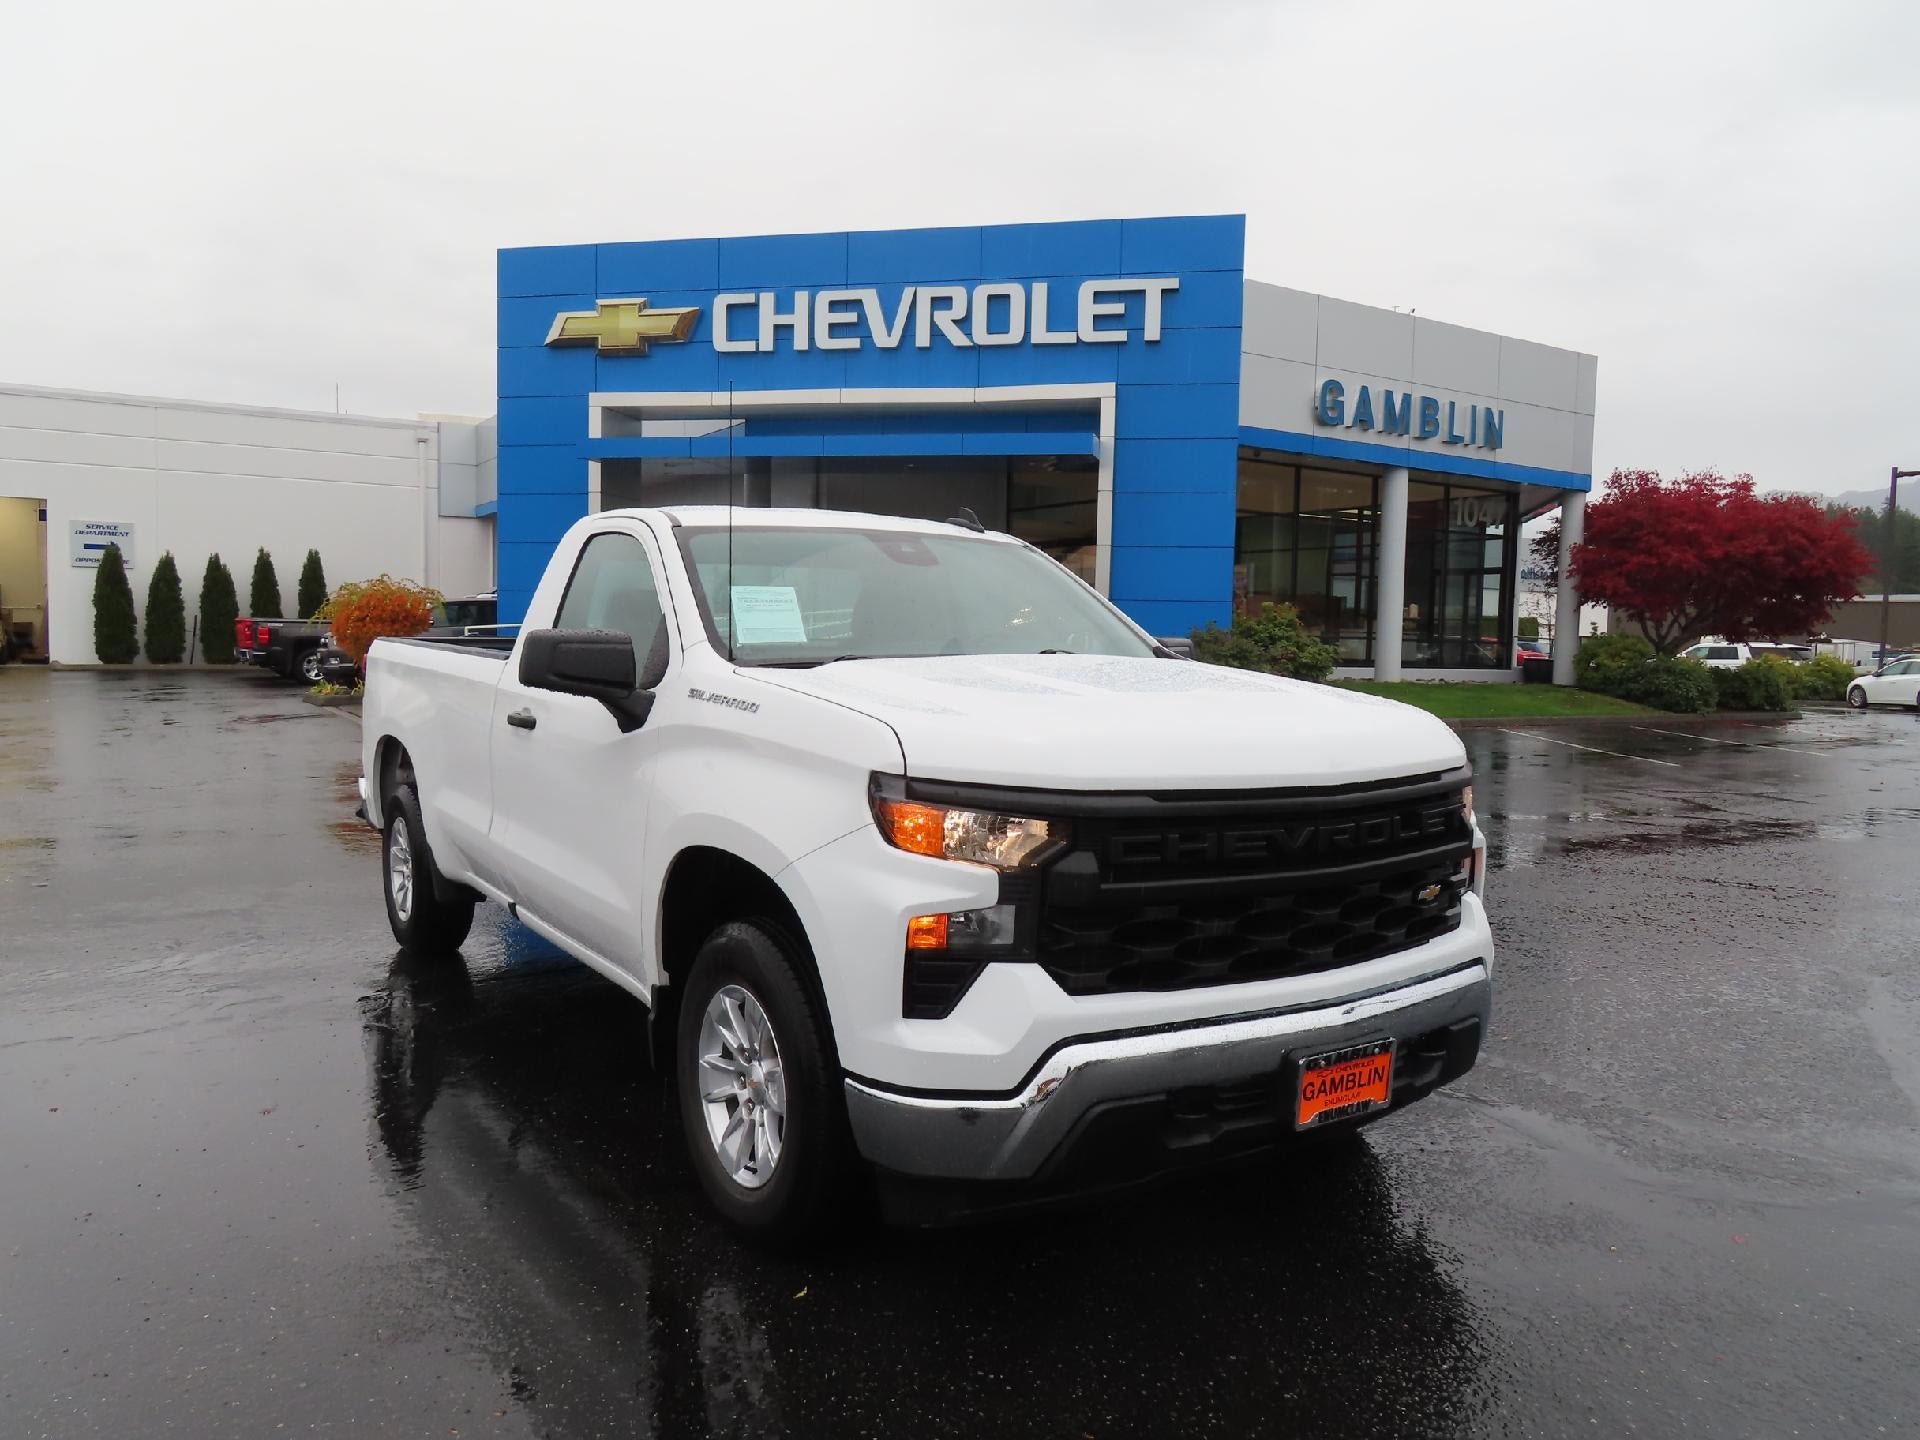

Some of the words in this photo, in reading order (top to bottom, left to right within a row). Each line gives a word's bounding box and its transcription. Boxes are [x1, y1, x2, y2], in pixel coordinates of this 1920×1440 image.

[712, 277, 1180, 353] CHEVROLET
[1316, 379, 1504, 449] GAMBLIN
[687, 687, 761, 714] SILVERADO
[1302, 1066, 1386, 1102] GAMBLIN
[1324, 1091, 1361, 1107] ENUMCLAW
